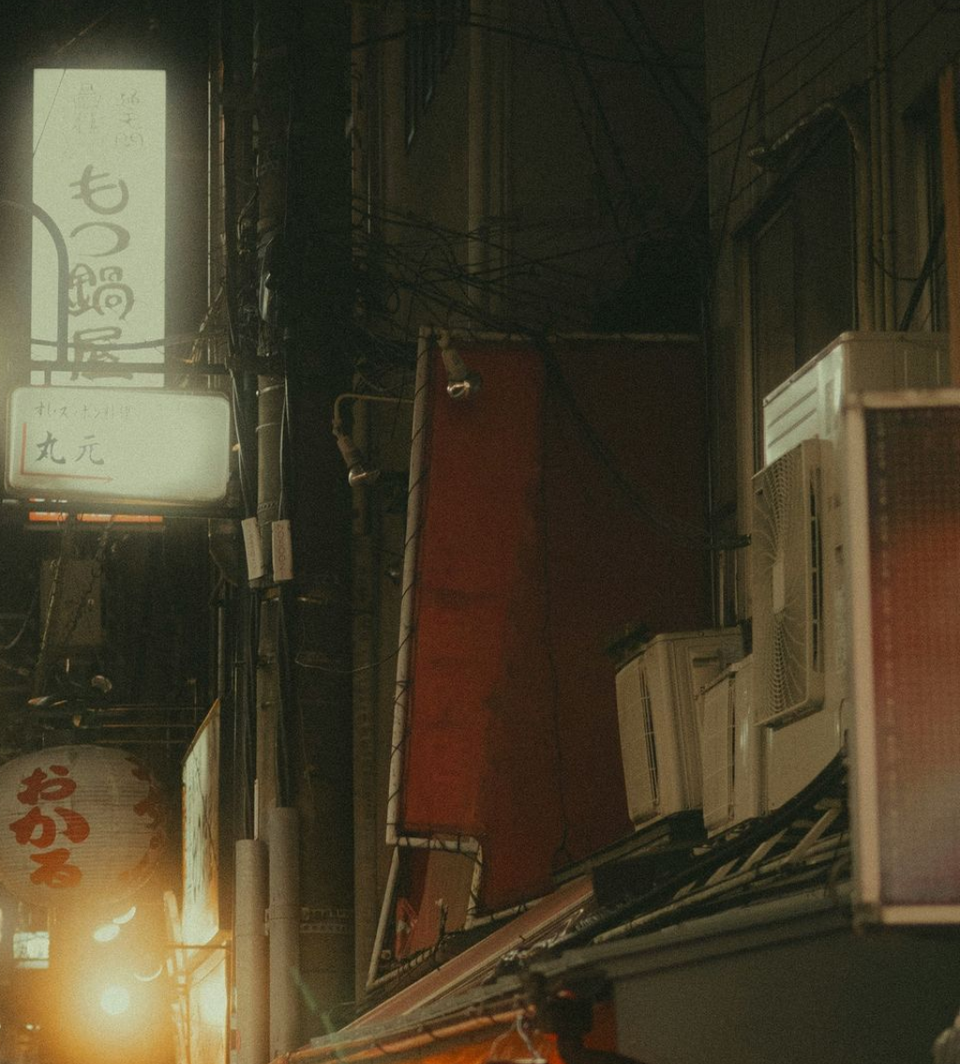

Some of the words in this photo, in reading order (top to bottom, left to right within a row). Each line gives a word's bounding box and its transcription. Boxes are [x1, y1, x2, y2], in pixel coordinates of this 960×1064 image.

[68, 163, 135, 382] もつ鍋屋
[34, 430, 106, 466] 丸元
[8, 764, 91, 889] おかる
